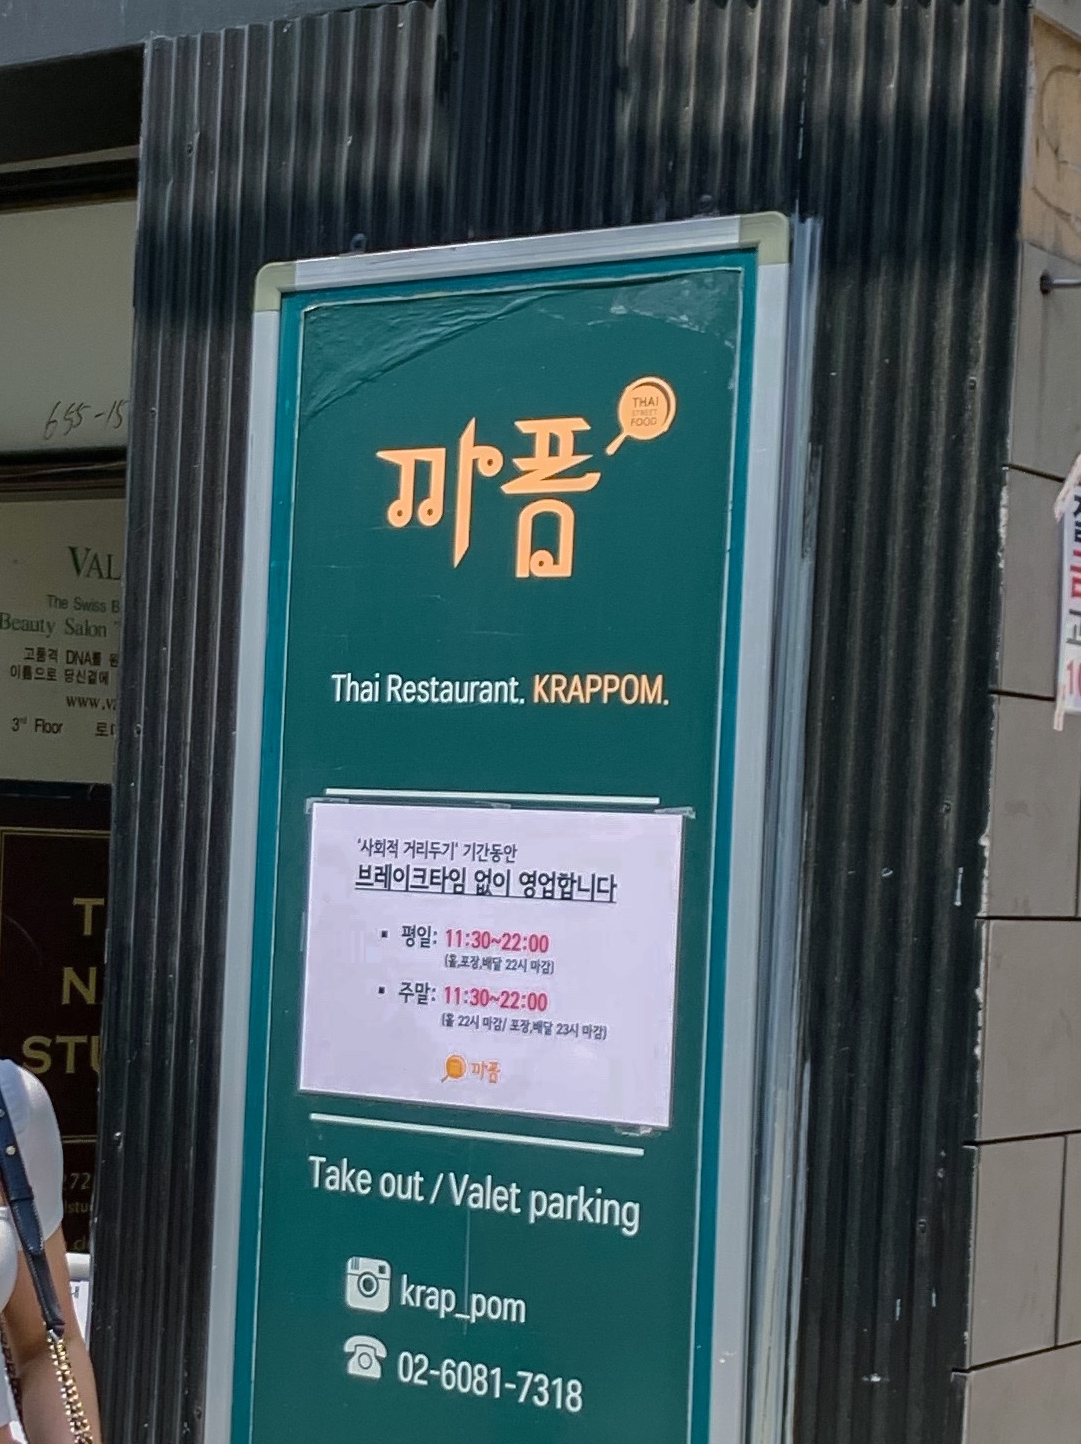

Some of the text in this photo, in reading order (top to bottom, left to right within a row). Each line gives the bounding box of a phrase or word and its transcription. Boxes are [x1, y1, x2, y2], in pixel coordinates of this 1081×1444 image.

[632, 396, 659, 408] THAI
[630, 417, 658, 427] FOOD
[46, 594, 69, 610] The
[73, 596, 107, 613] Swiss
[64, 617, 108, 638] Salon
[24, 646, 59, 663] 고품격
[66, 649, 102, 667] DNA를
[10, 664, 58, 682] 이름으로
[331, 673, 670, 706] Thai Restaurant. KRAPPOM.
[34, 718, 64, 734] Floor
[463, 842, 518, 864] 기간동안
[357, 863, 618, 903] 브레이크타임 없이 영업합니다
[401, 924, 550, 954] 평일: 11:30~22:00
[505, 958, 528, 974] 22시
[398, 982, 549, 1012] 주말: 11:30~22:00
[458, 1015, 480, 1030] 22시
[556, 1022, 580, 1038] 23시
[308, 1155, 372, 1194] Take
[379, 1170, 424, 1202] out
[449, 1172, 522, 1214] Valet
[528, 1186, 641, 1237] parking
[399, 1273, 527, 1324] krap_pom
[396, 1350, 584, 1413] 02-6081-7318
